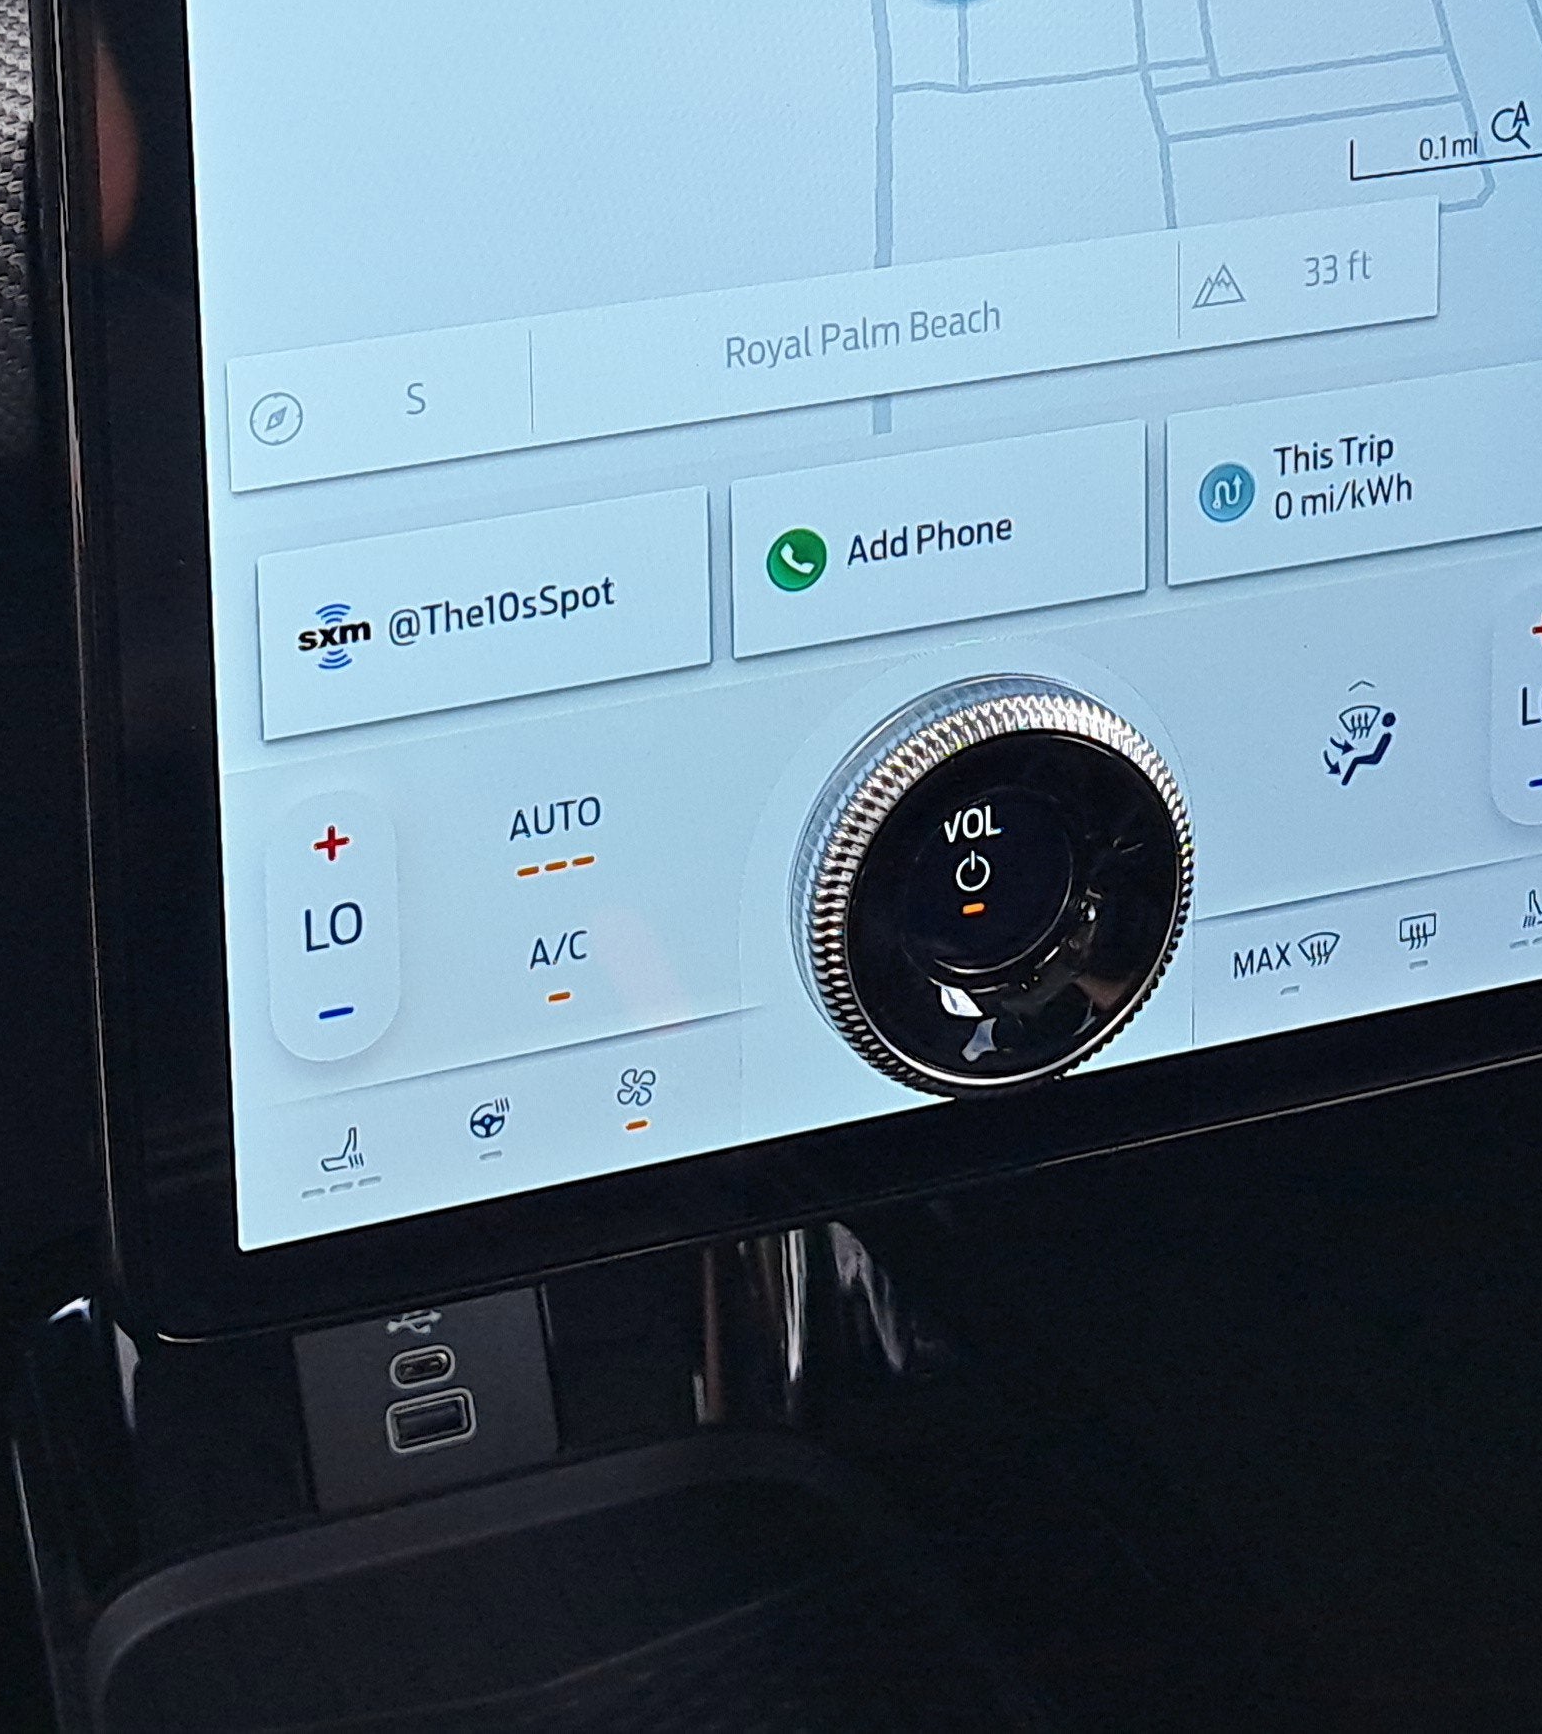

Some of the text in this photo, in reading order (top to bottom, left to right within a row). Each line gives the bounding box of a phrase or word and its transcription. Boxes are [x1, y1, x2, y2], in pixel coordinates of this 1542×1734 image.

[1304, 250, 1373, 287] 33 ft
[725, 302, 1002, 369] Royal Palm Beach
[405, 382, 427, 416] S
[1274, 434, 1395, 479] This Trip
[1274, 474, 1413, 521] 0 mi/kWh
[846, 513, 1014, 567] Add Phone
[387, 575, 616, 647] @The10sSpot
[297, 618, 372, 652] sxm
[509, 796, 601, 842] AUTO
[942, 805, 1003, 843] VOL
[304, 901, 363, 953] LO
[529, 930, 589, 969] A/C
[1232, 941, 1295, 981] MAX
